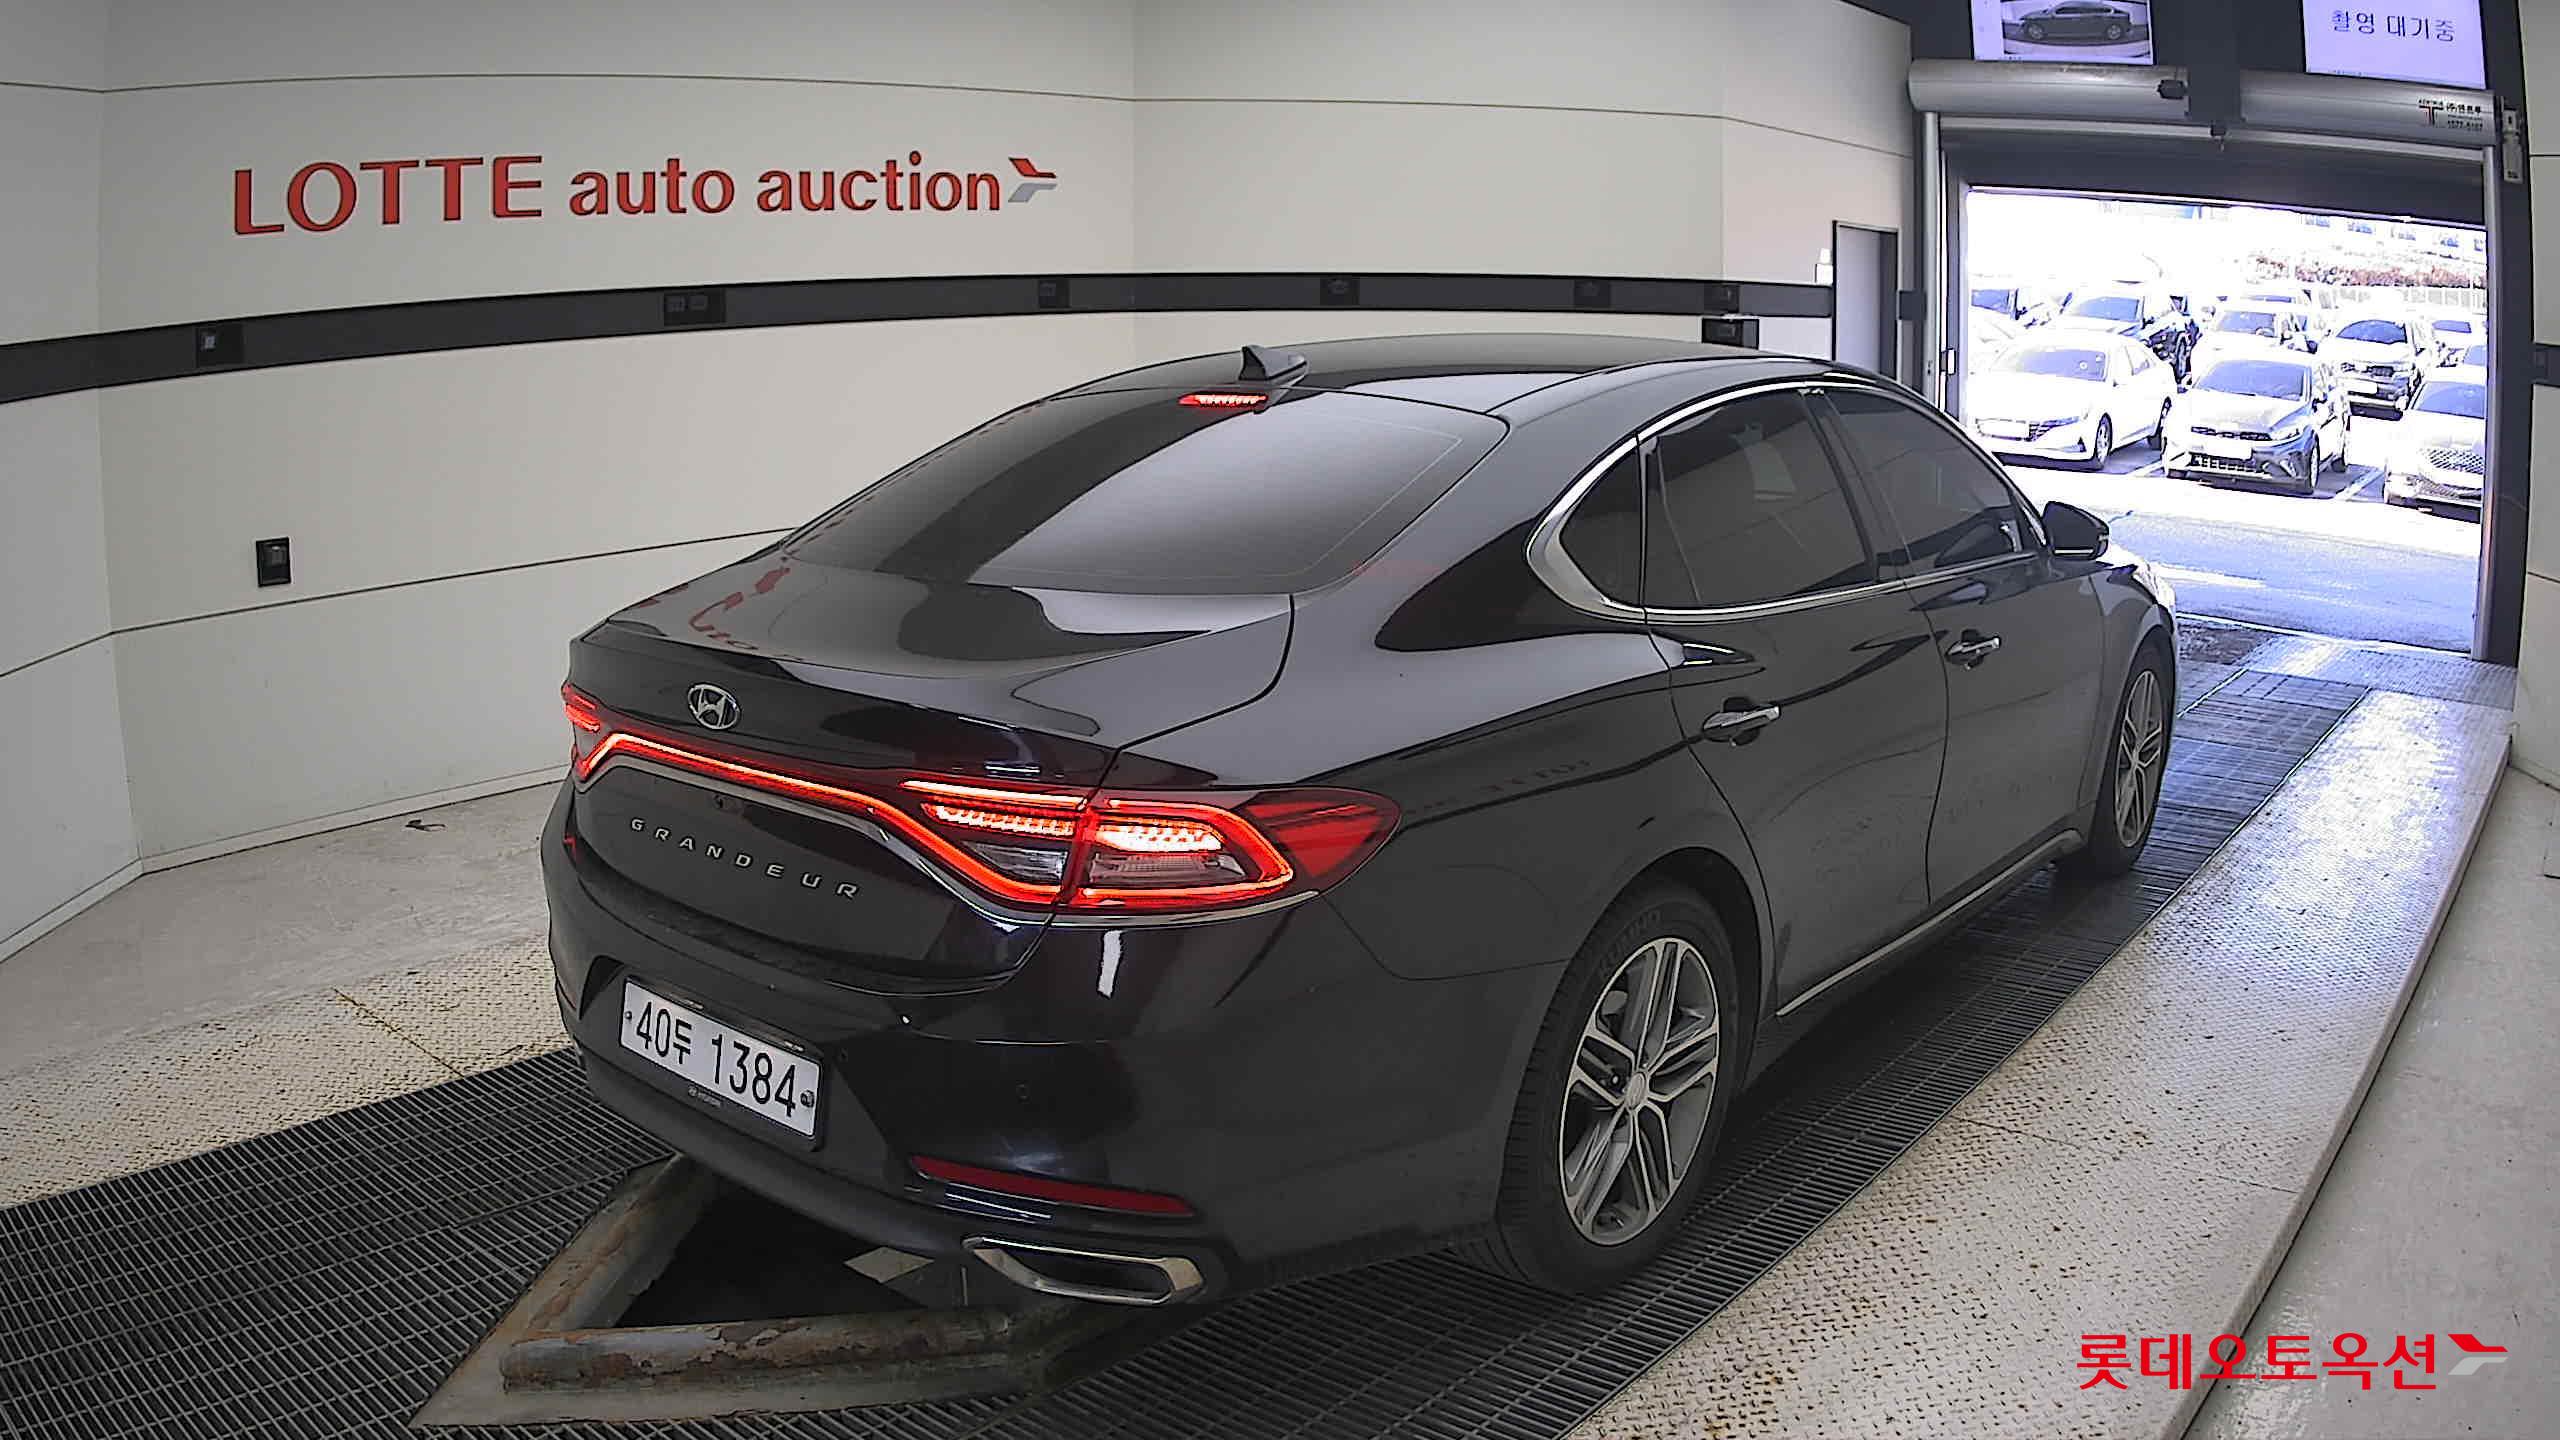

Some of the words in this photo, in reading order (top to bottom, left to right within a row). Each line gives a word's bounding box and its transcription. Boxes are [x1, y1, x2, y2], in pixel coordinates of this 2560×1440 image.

[2332, 10, 2375, 34] 촬영
[2386, 15, 2454, 42] 대기중
[236, 158, 541, 235] LOTTE
[569, 159, 734, 214] auto
[757, 152, 1001, 213] auction
[630, 817, 858, 899] GRANDEUR
[635, 1001, 693, 1066] 40두
[711, 1033, 798, 1118] 1384
